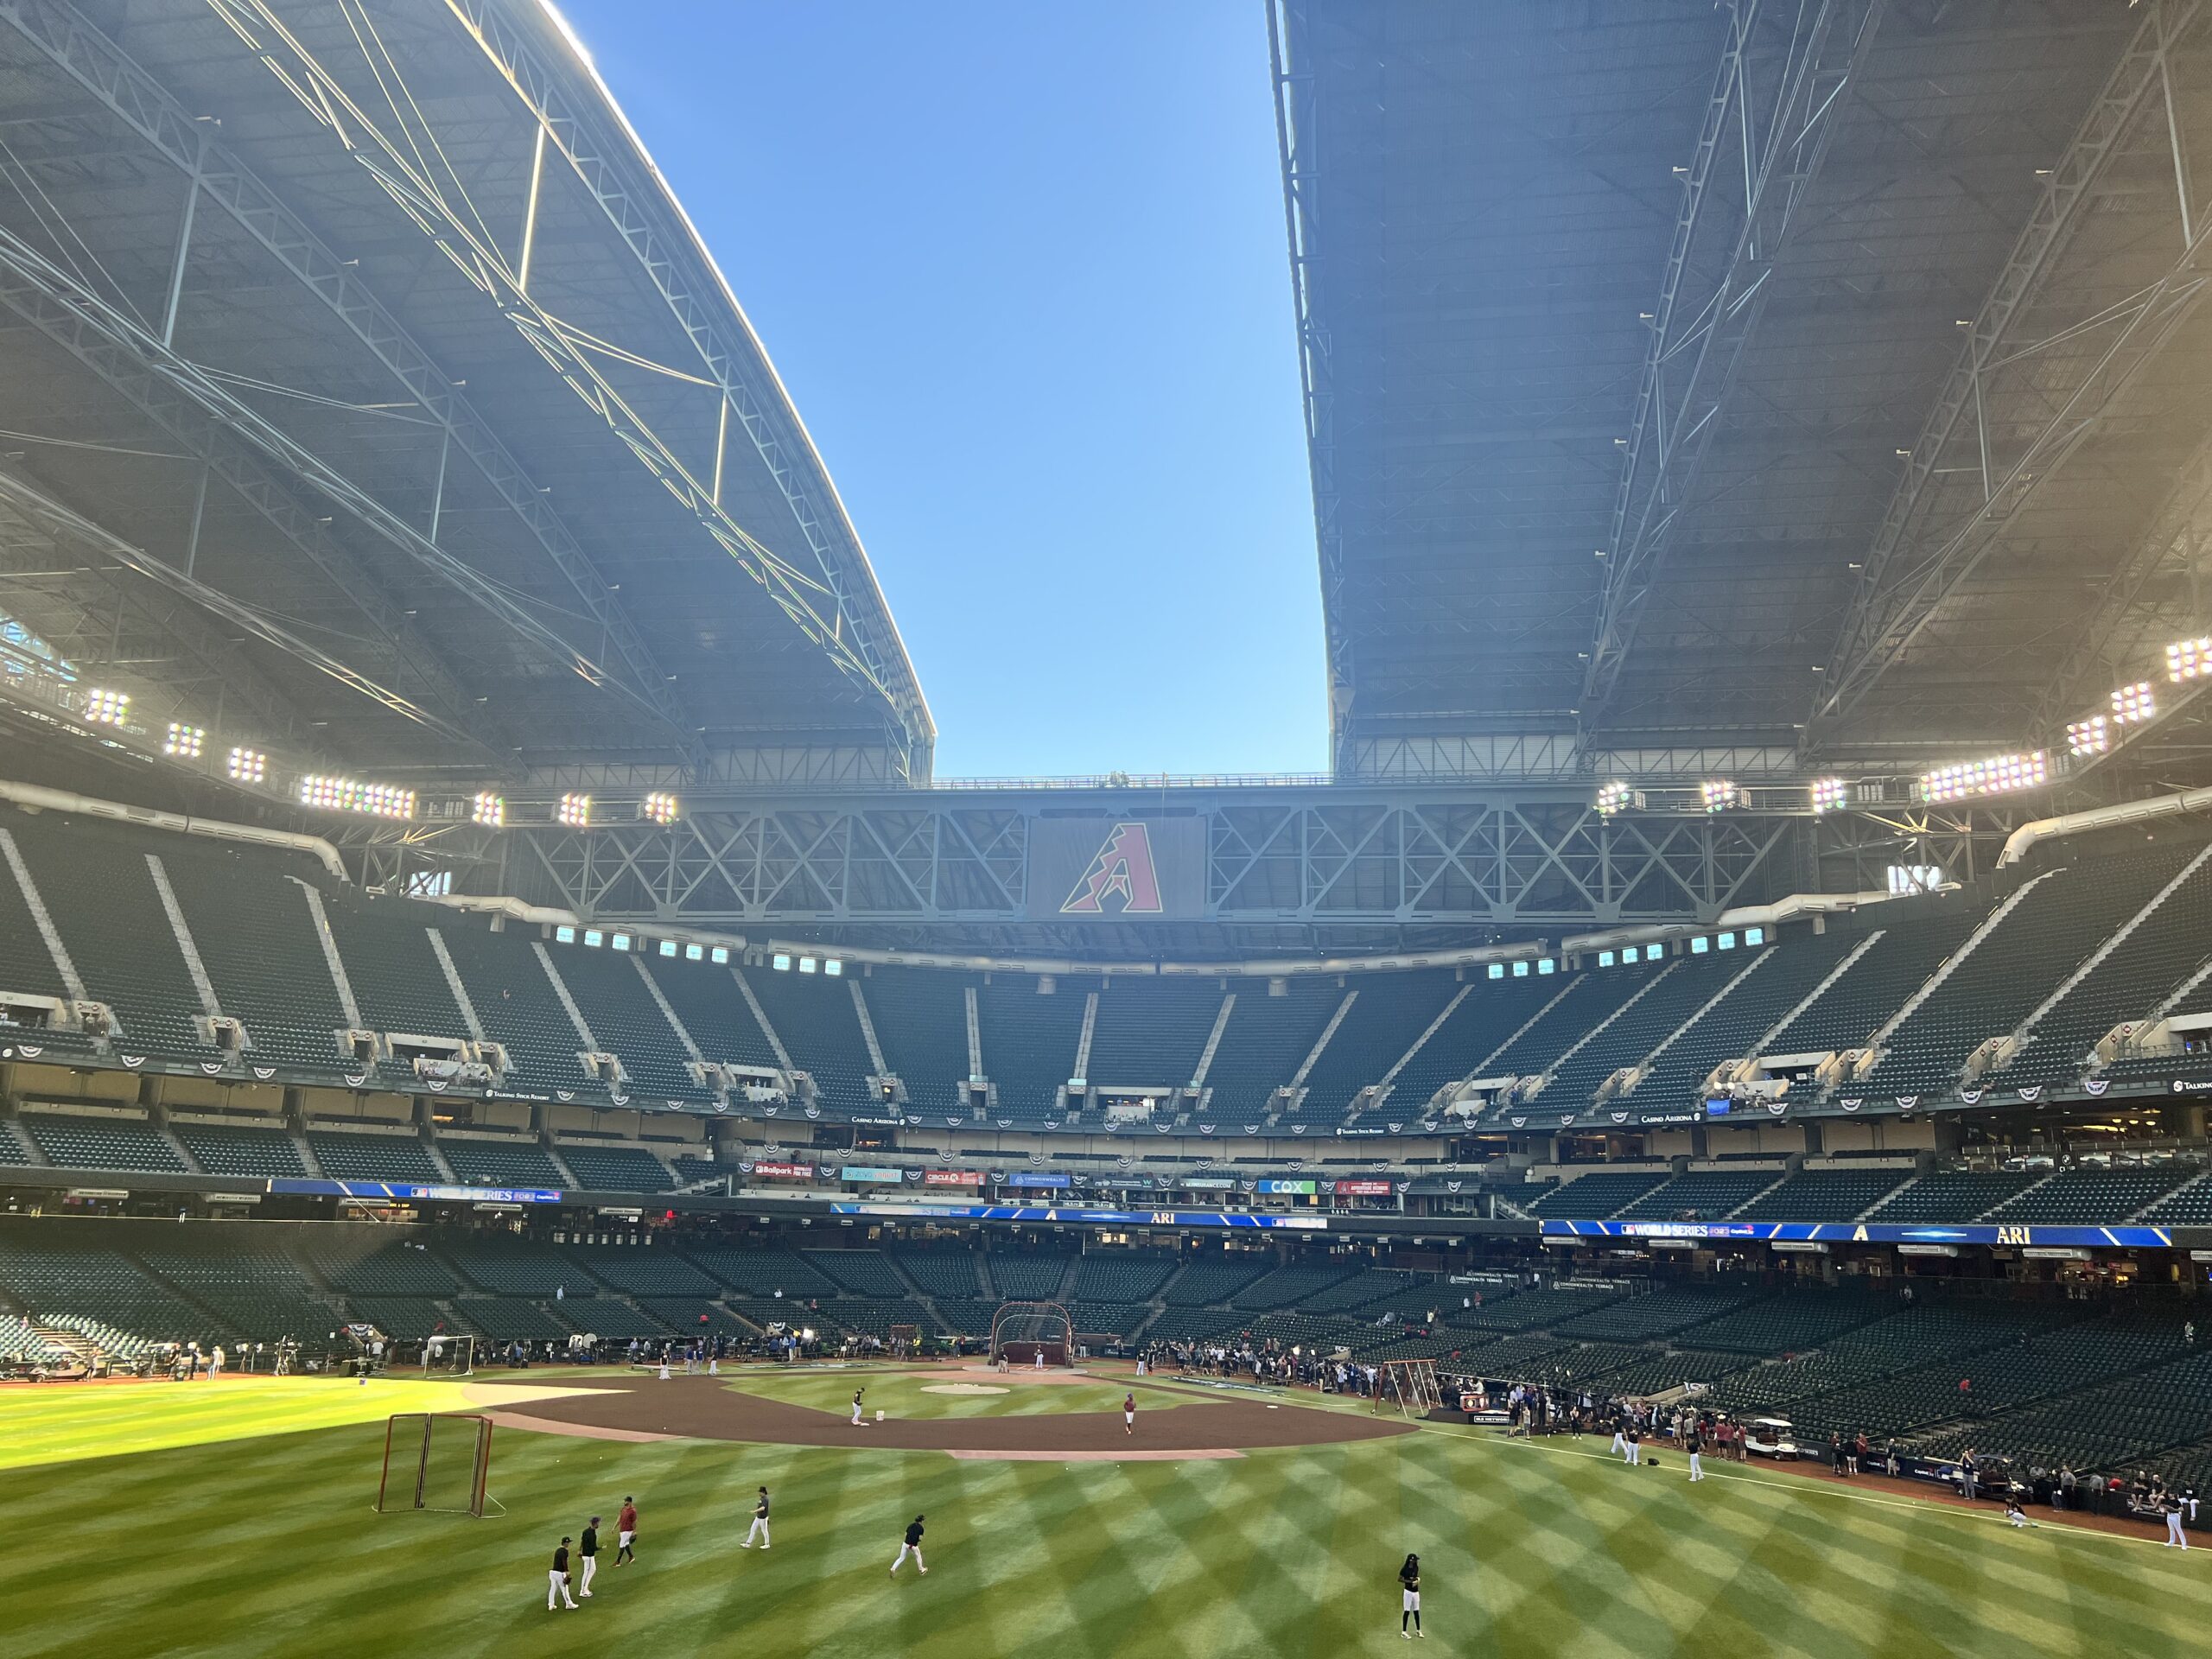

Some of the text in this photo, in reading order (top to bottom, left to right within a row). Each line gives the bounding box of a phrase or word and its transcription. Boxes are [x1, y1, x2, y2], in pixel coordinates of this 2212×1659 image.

[1665, 1114, 1693, 1122] ARIZONA
[764, 1166, 792, 1175] Ballpark
[1271, 1180, 1304, 1193] COX
[1045, 1209, 1057, 1221] A
[1150, 1212, 1175, 1224] ARI
[1635, 1224, 1671, 1236] WORLD
[1672, 1224, 1707, 1236] SERIES
[1852, 1224, 1869, 1241] A
[1996, 1226, 2031, 1244] ARI
